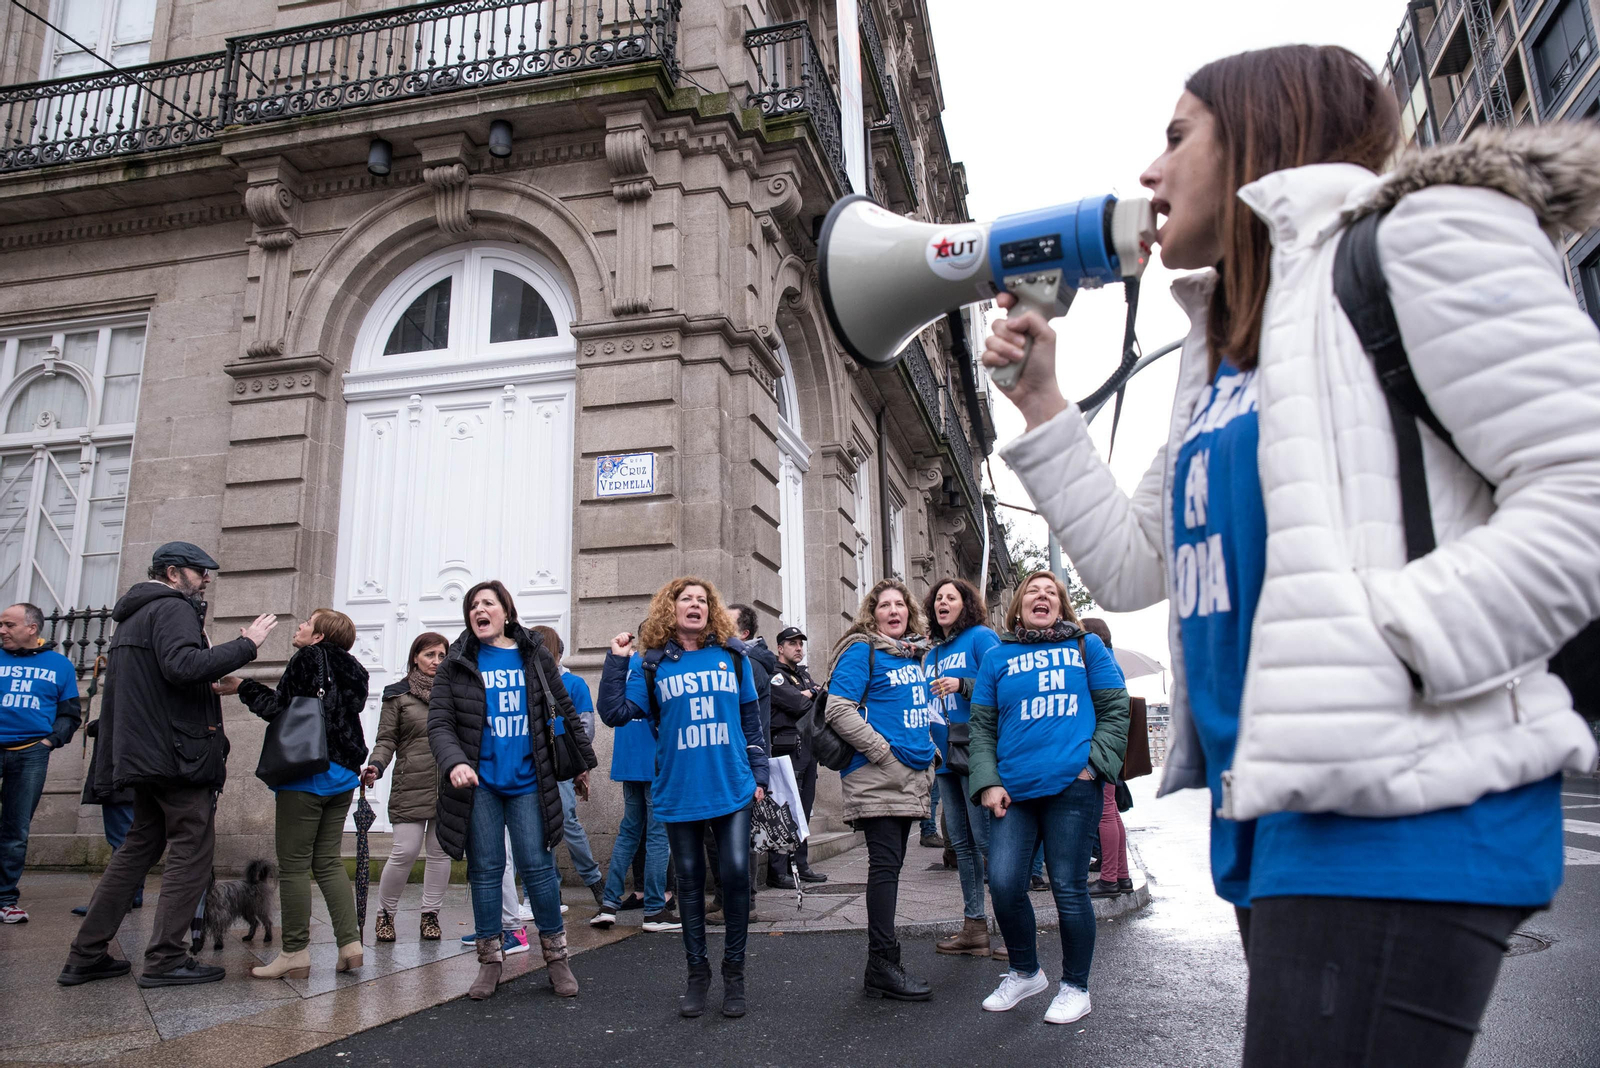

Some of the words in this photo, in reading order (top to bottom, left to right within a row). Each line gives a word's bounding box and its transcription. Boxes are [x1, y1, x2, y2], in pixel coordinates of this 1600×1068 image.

[938, 240, 977, 258] CUT
[620, 465, 647, 476] CRUZ
[600, 479, 652, 491] VERMELLA
[10, 679, 33, 692] EN
[481, 669, 526, 689] USTI
[656, 670, 738, 703] XUSTIZA
[1038, 668, 1066, 693] EN
[0, 693, 40, 710] OITA
[498, 690, 521, 713] EN
[911, 685, 926, 706] EN
[689, 696, 715, 721] EN
[1020, 693, 1079, 721] LOITA
[903, 707, 930, 729] LOIT
[677, 722, 730, 750] LOITA
